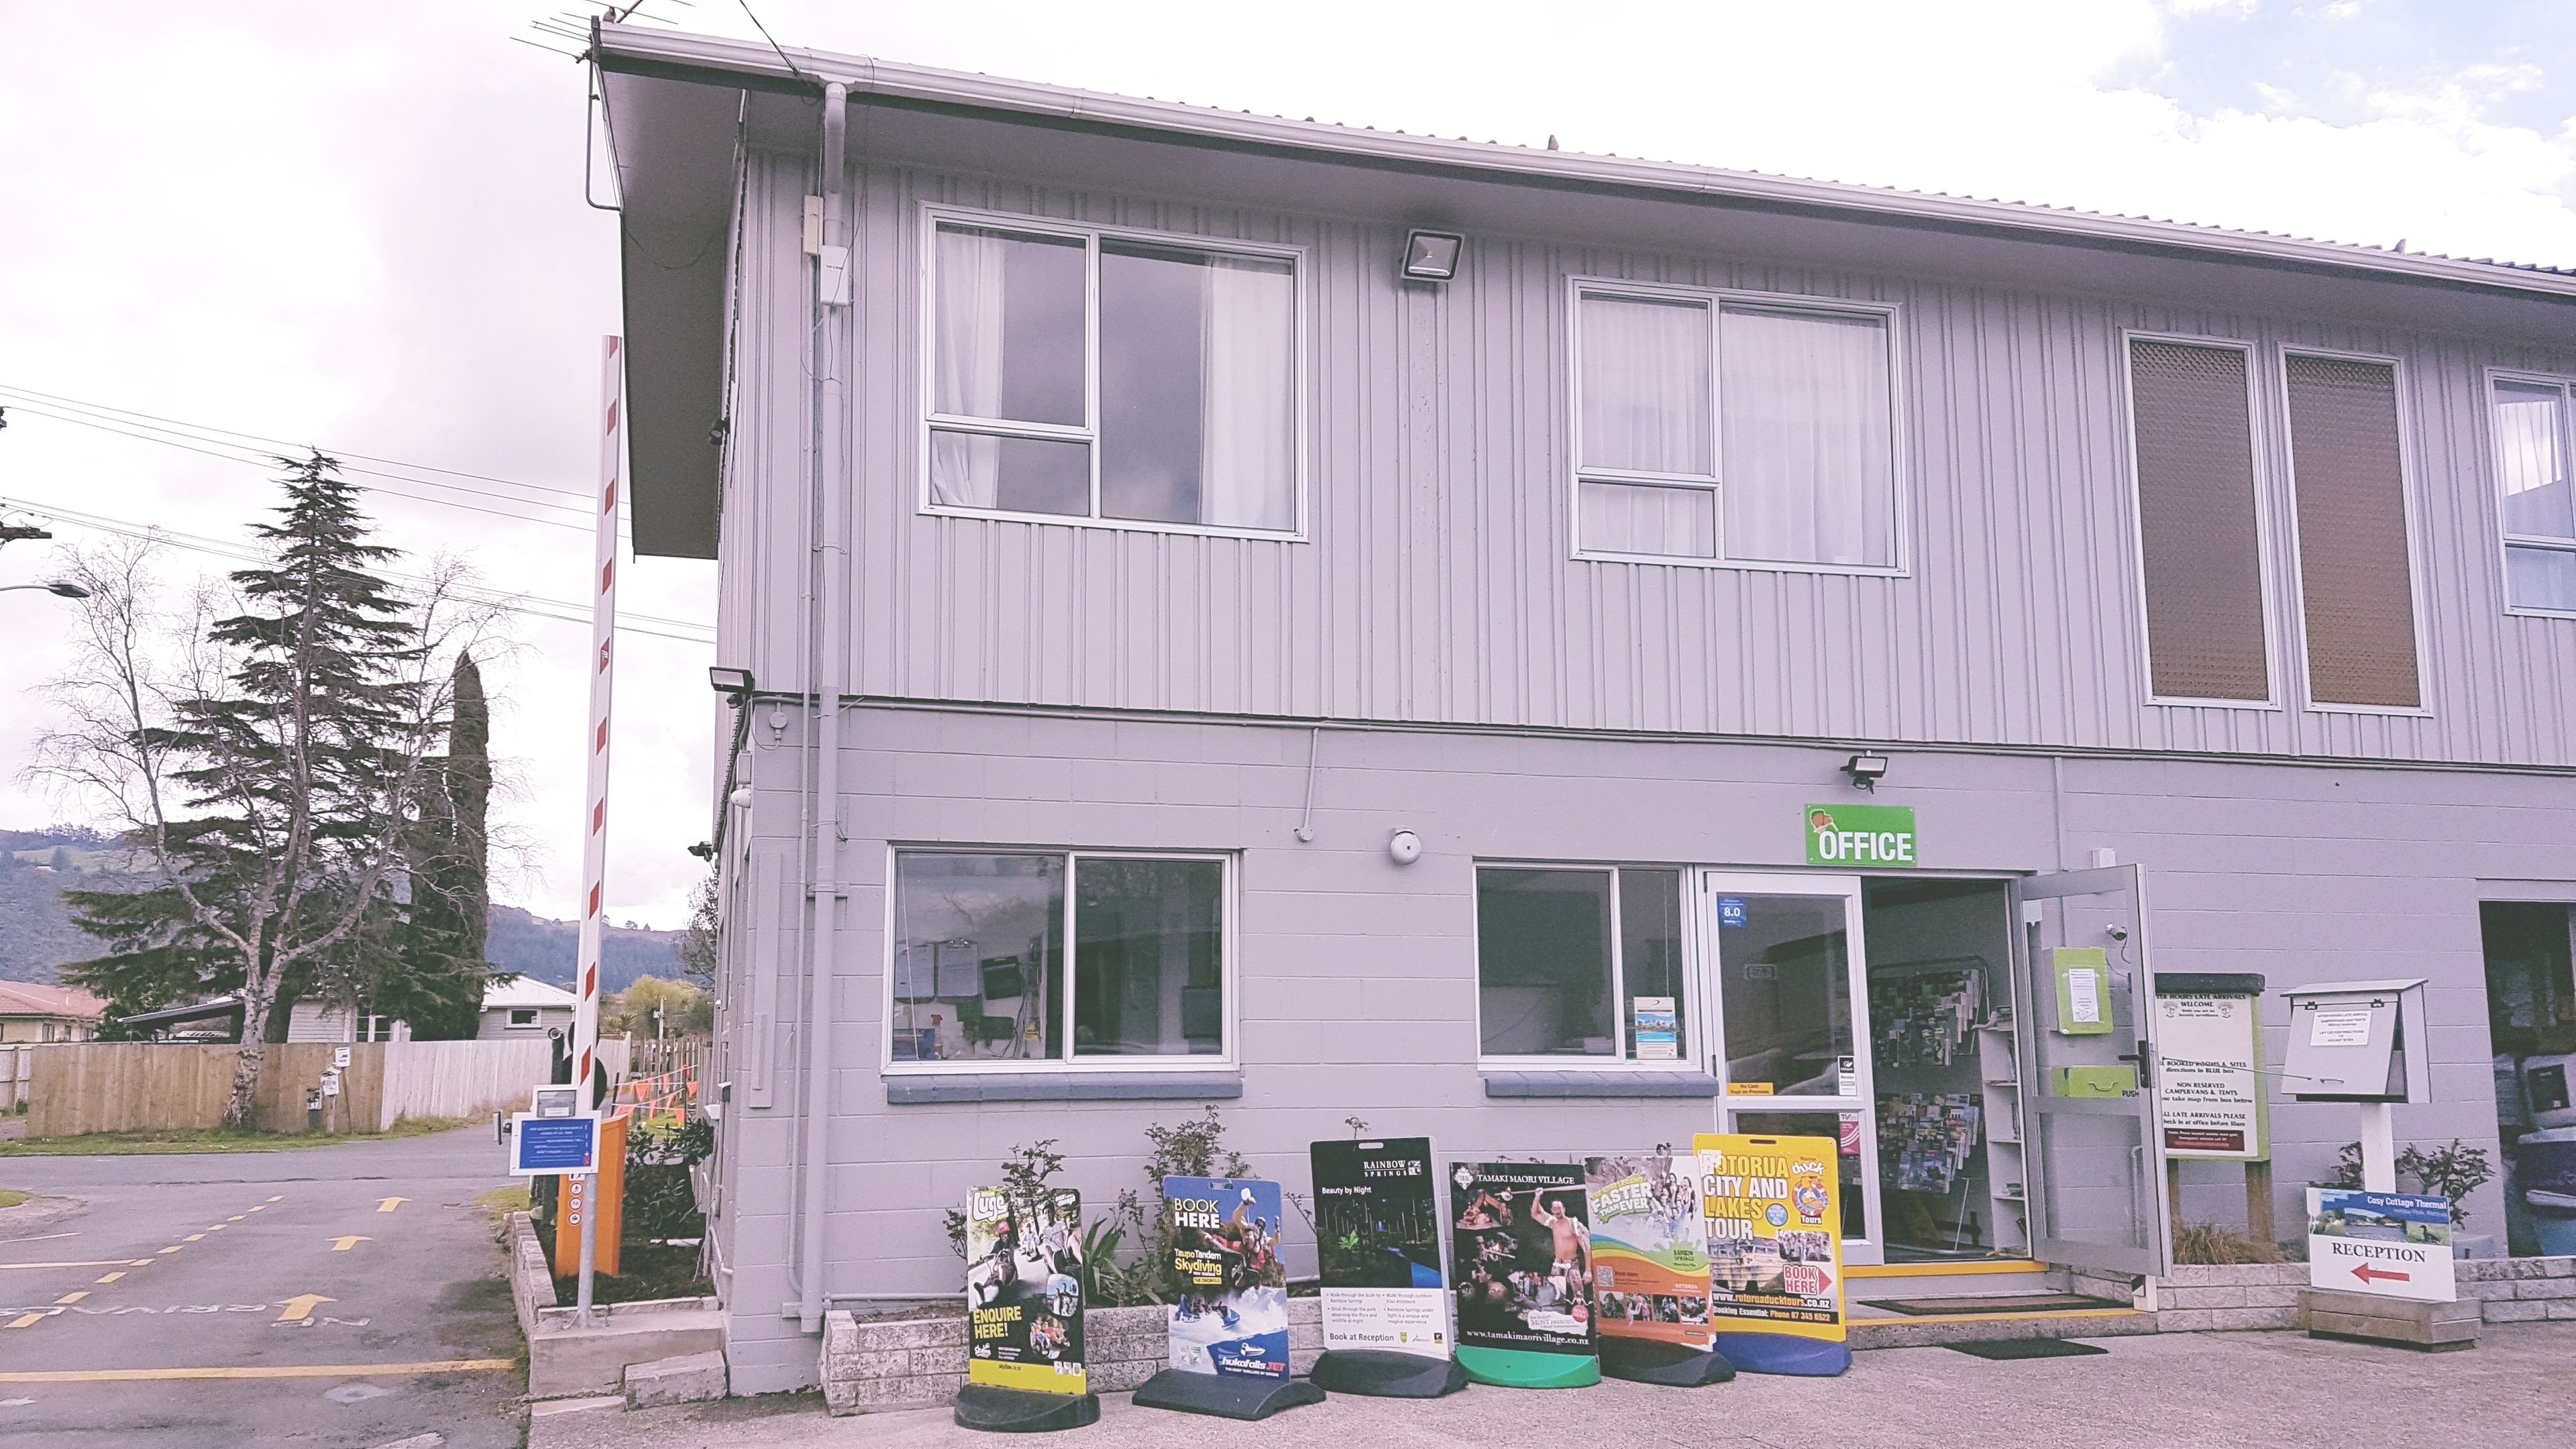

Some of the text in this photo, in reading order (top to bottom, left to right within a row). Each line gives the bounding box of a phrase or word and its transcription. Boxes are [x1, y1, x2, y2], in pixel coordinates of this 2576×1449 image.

[1819, 831, 1913, 861] OFFICE
[1724, 907, 1740, 916] 8.0
[2122, 1090, 2139, 1098] PUSH
[1364, 1160, 1406, 1169] RAINBOW
[1705, 1155, 1789, 1178] OTORUA
[1477, 1175, 1508, 1183] TAMAKI
[1510, 1175, 1537, 1183] MAORI
[1322, 1186, 1372, 1195] Beauty by Night
[1703, 1175, 1788, 1199] CITY AND
[1175, 1198, 1219, 1213] BOOK
[1591, 1182, 1653, 1214] FASTER
[2367, 1196, 2447, 1210] Cosy Cottage Thermal
[973, 1191, 1008, 1222] Luge
[1599, 1197, 1649, 1216] THAN EVER
[1705, 1196, 1764, 1220] LAKES
[1175, 1212, 1220, 1228] HERE
[1801, 1216, 1822, 1224] Tours
[1705, 1217, 1753, 1240] TOUR
[2332, 1242, 2426, 1263] RECEPTION
[1175, 1257, 1222, 1276] Skydiving
[1784, 1266, 1817, 1280] BOOK
[1785, 1280, 1817, 1294] HERE
[1713, 1293, 1830, 1309] www.rotoruaducktours.co.nz
[973, 1305, 1022, 1324] ENQUIRE
[1739, 1307, 1769, 1317] Essential:
[1770, 1311, 1790, 1320] Phone
[1791, 1311, 1799, 1320] 07
[1801, 1312, 1813, 1320] 345
[1814, 1313, 1830, 1322] 6522
[974, 1322, 1008, 1339] HERE!
[1358, 1334, 1394, 1342] Reception
[1466, 1330, 1589, 1345] www.tamakimaorivillage.co.nz
[1222, 1356, 1287, 1371] hukafalls JET
